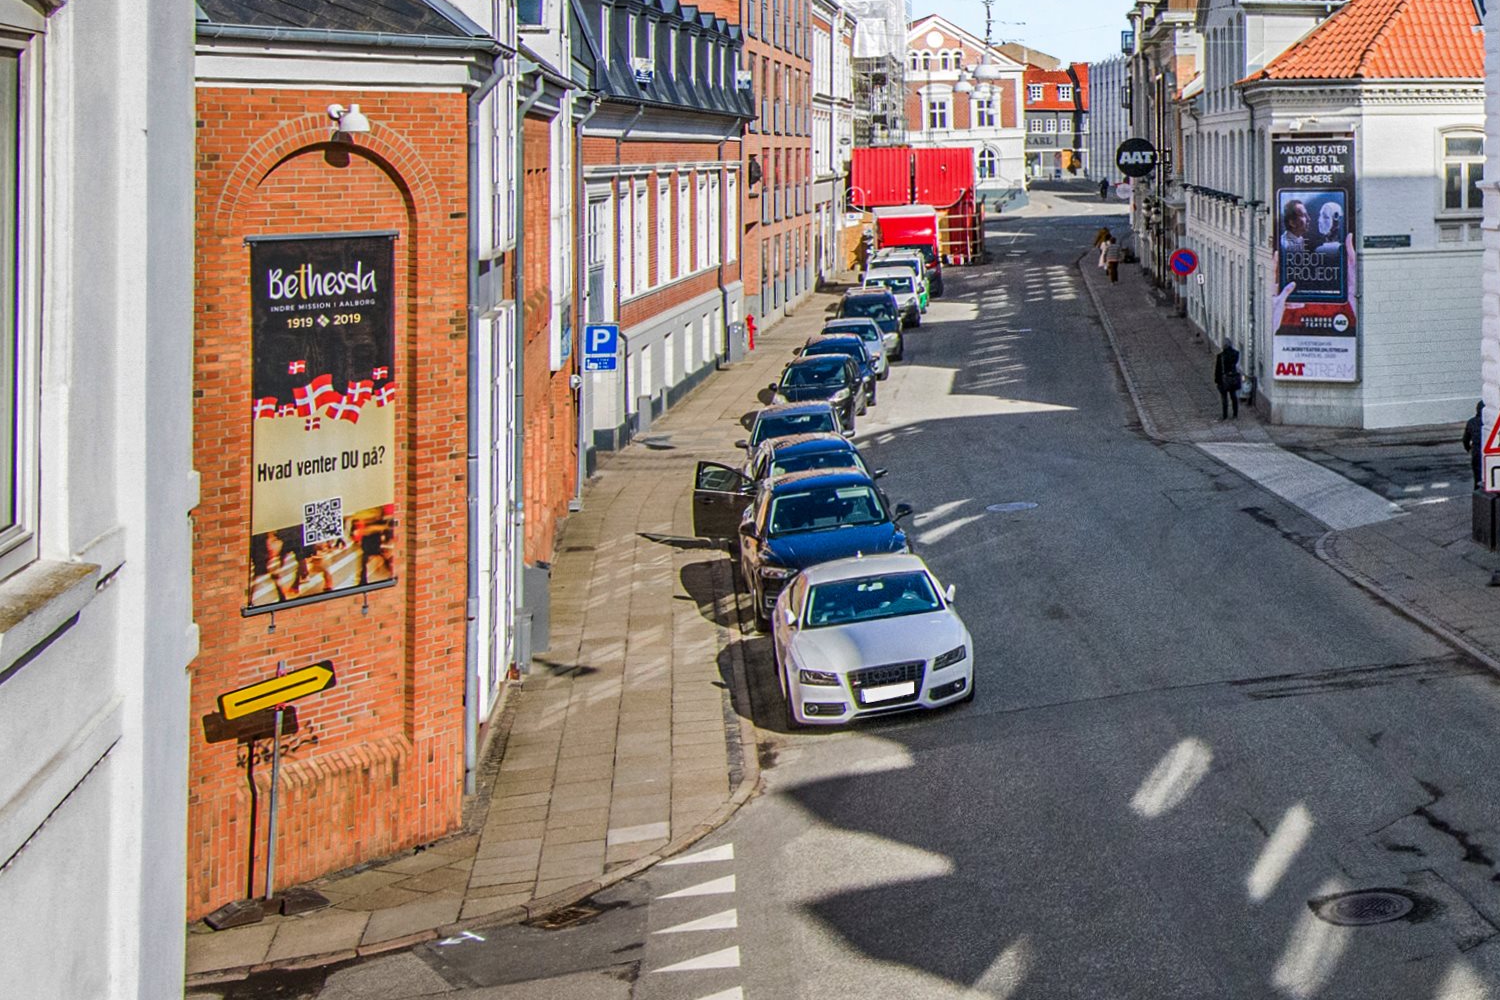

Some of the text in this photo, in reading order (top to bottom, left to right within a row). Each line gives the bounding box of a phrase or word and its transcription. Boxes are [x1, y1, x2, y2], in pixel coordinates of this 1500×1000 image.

[1280, 145, 1348, 155] AALBORG TEATER
[1120, 151, 1153, 164] AAT
[1287, 155, 1340, 164] INVITERER TIL
[1283, 165, 1345, 173] GRATIS ONLINE
[1294, 174, 1333, 183] PREMIERE
[1286, 252, 1326, 266] ROBOT
[268, 261, 377, 299] Bethesda
[1286, 267, 1340, 281] PROJECT
[298, 302, 331, 310] MISSION
[339, 299, 375, 307] AALBORG
[287, 313, 361, 328] 1919 2019
[592, 329, 610, 351] P
[257, 445, 386, 482] Hvad venter DU på?
